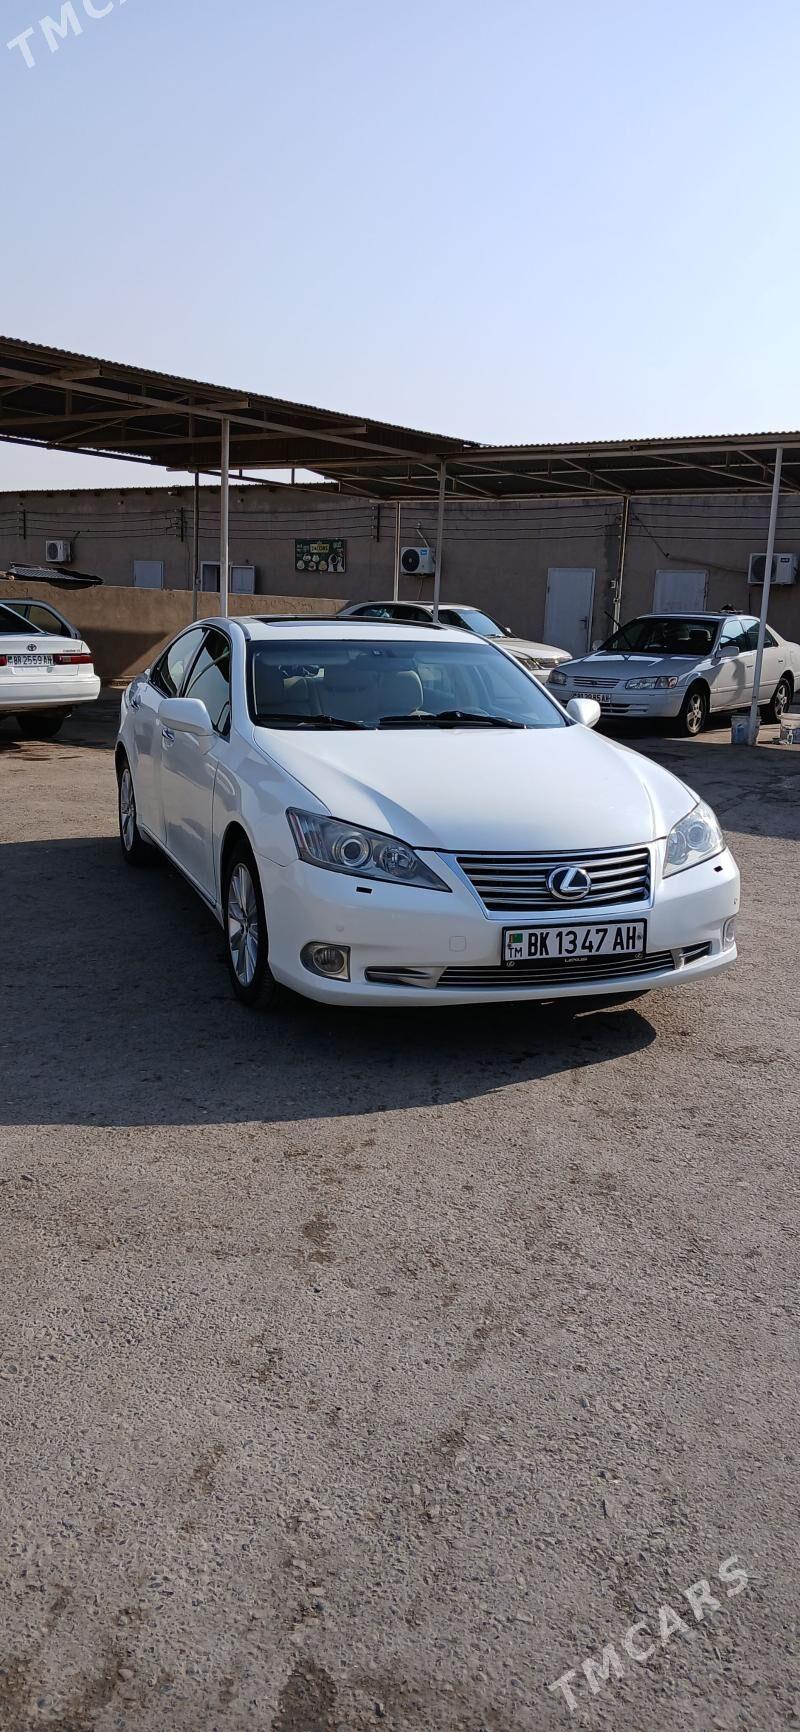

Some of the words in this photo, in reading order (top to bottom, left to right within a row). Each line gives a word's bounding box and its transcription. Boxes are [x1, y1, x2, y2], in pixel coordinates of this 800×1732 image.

[23, 655, 43, 665] 2559
[528, 932, 550, 957] BK
[556, 928, 608, 955] 1347
[613, 926, 637, 951] AH
[508, 947, 523, 958] TM
